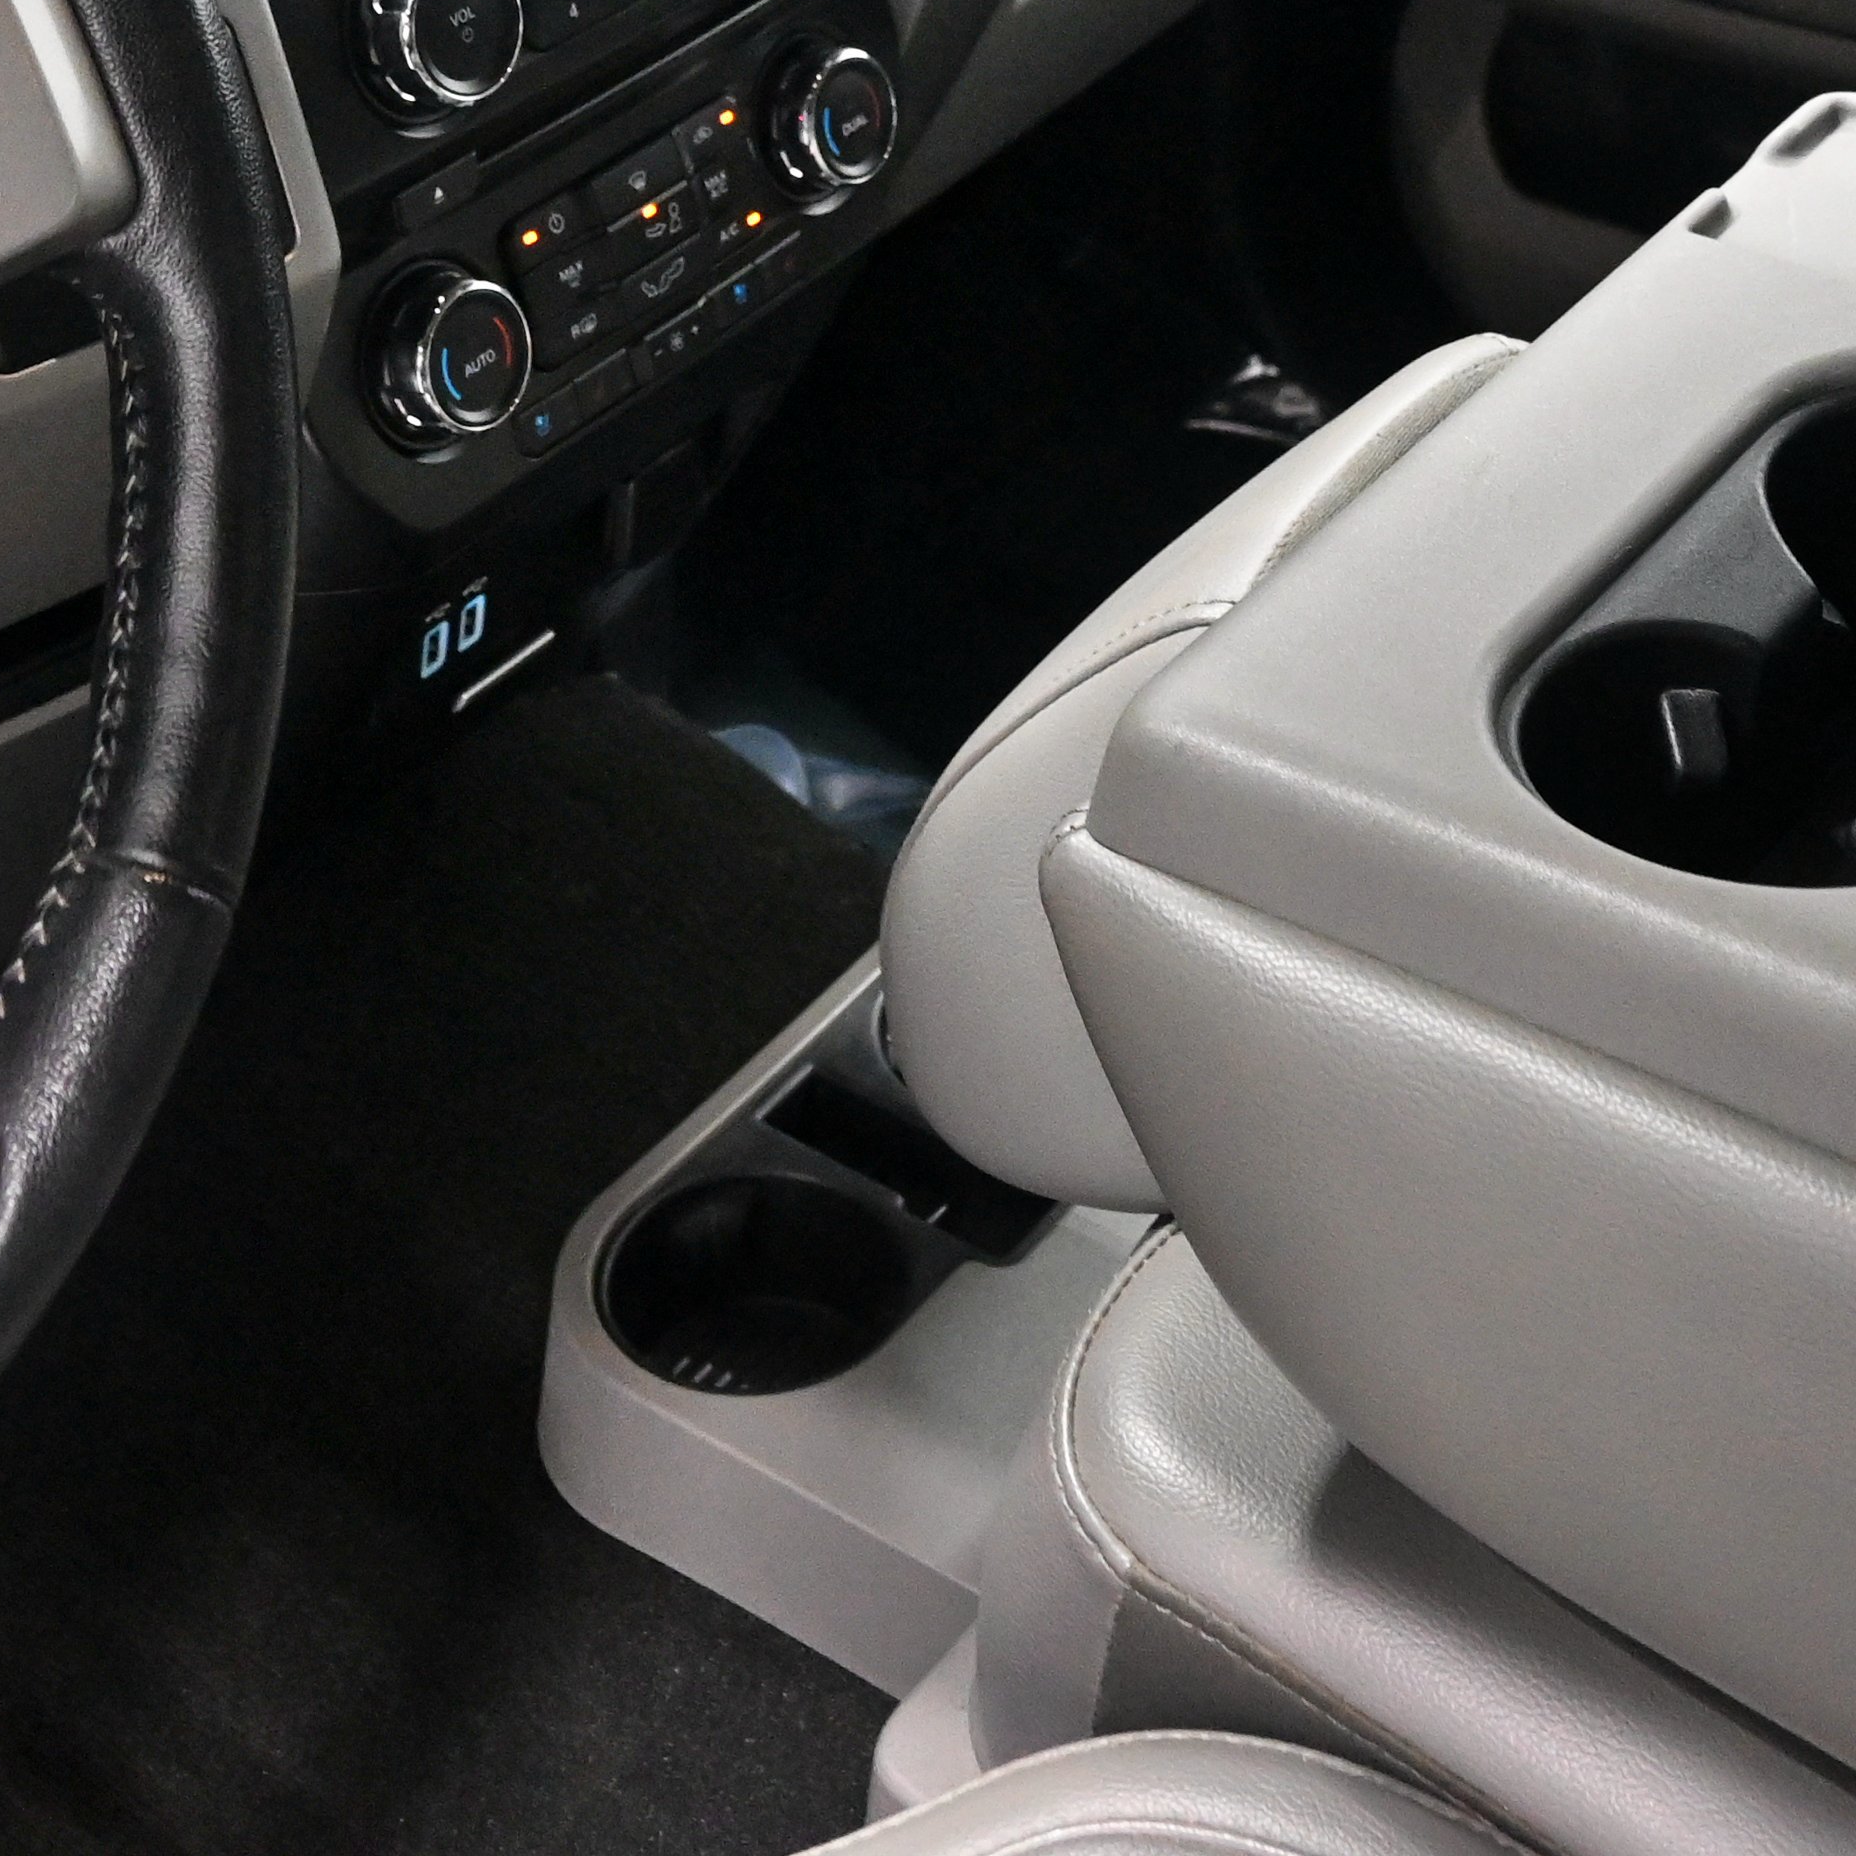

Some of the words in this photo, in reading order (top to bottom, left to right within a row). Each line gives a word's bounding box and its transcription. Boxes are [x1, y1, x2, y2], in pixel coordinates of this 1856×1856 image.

[449, 5, 477, 29] VOL
[559, 260, 584, 283] MAX
[463, 347, 497, 379] AUTO
